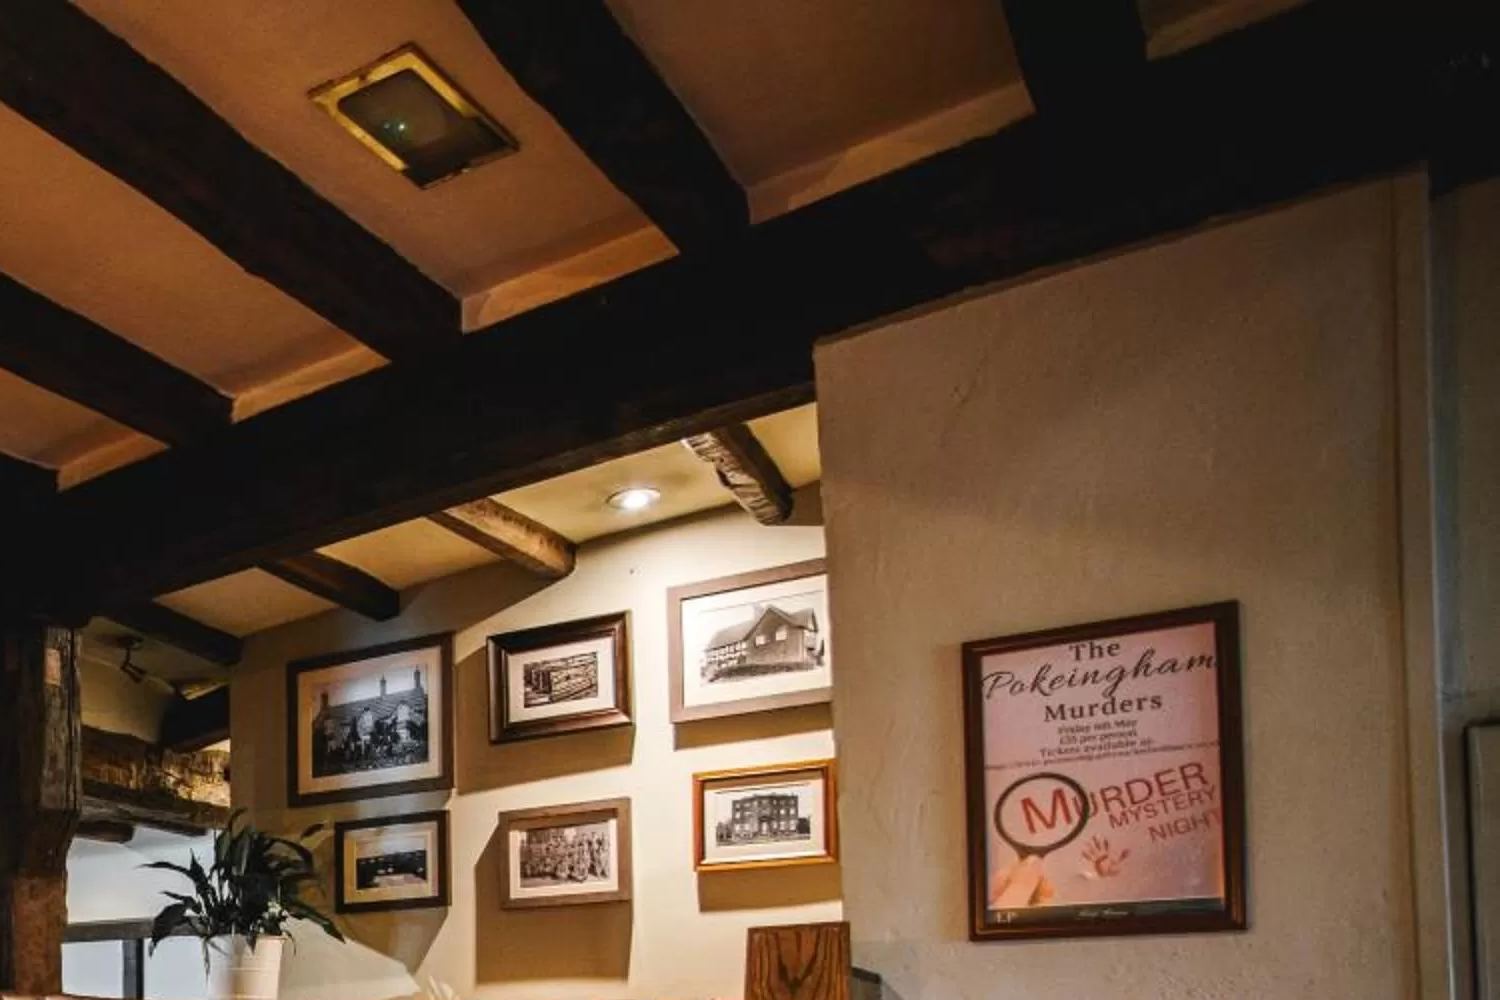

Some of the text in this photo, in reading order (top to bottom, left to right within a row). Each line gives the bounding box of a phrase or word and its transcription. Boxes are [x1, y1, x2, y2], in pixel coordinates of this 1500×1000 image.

[1069, 641, 1121, 662] The
[982, 648, 1218, 699] Pokeingham
[1043, 694, 1163, 722] Murders
[1113, 719, 1137, 729] May
[1107, 784, 1216, 829] MYSTERY
